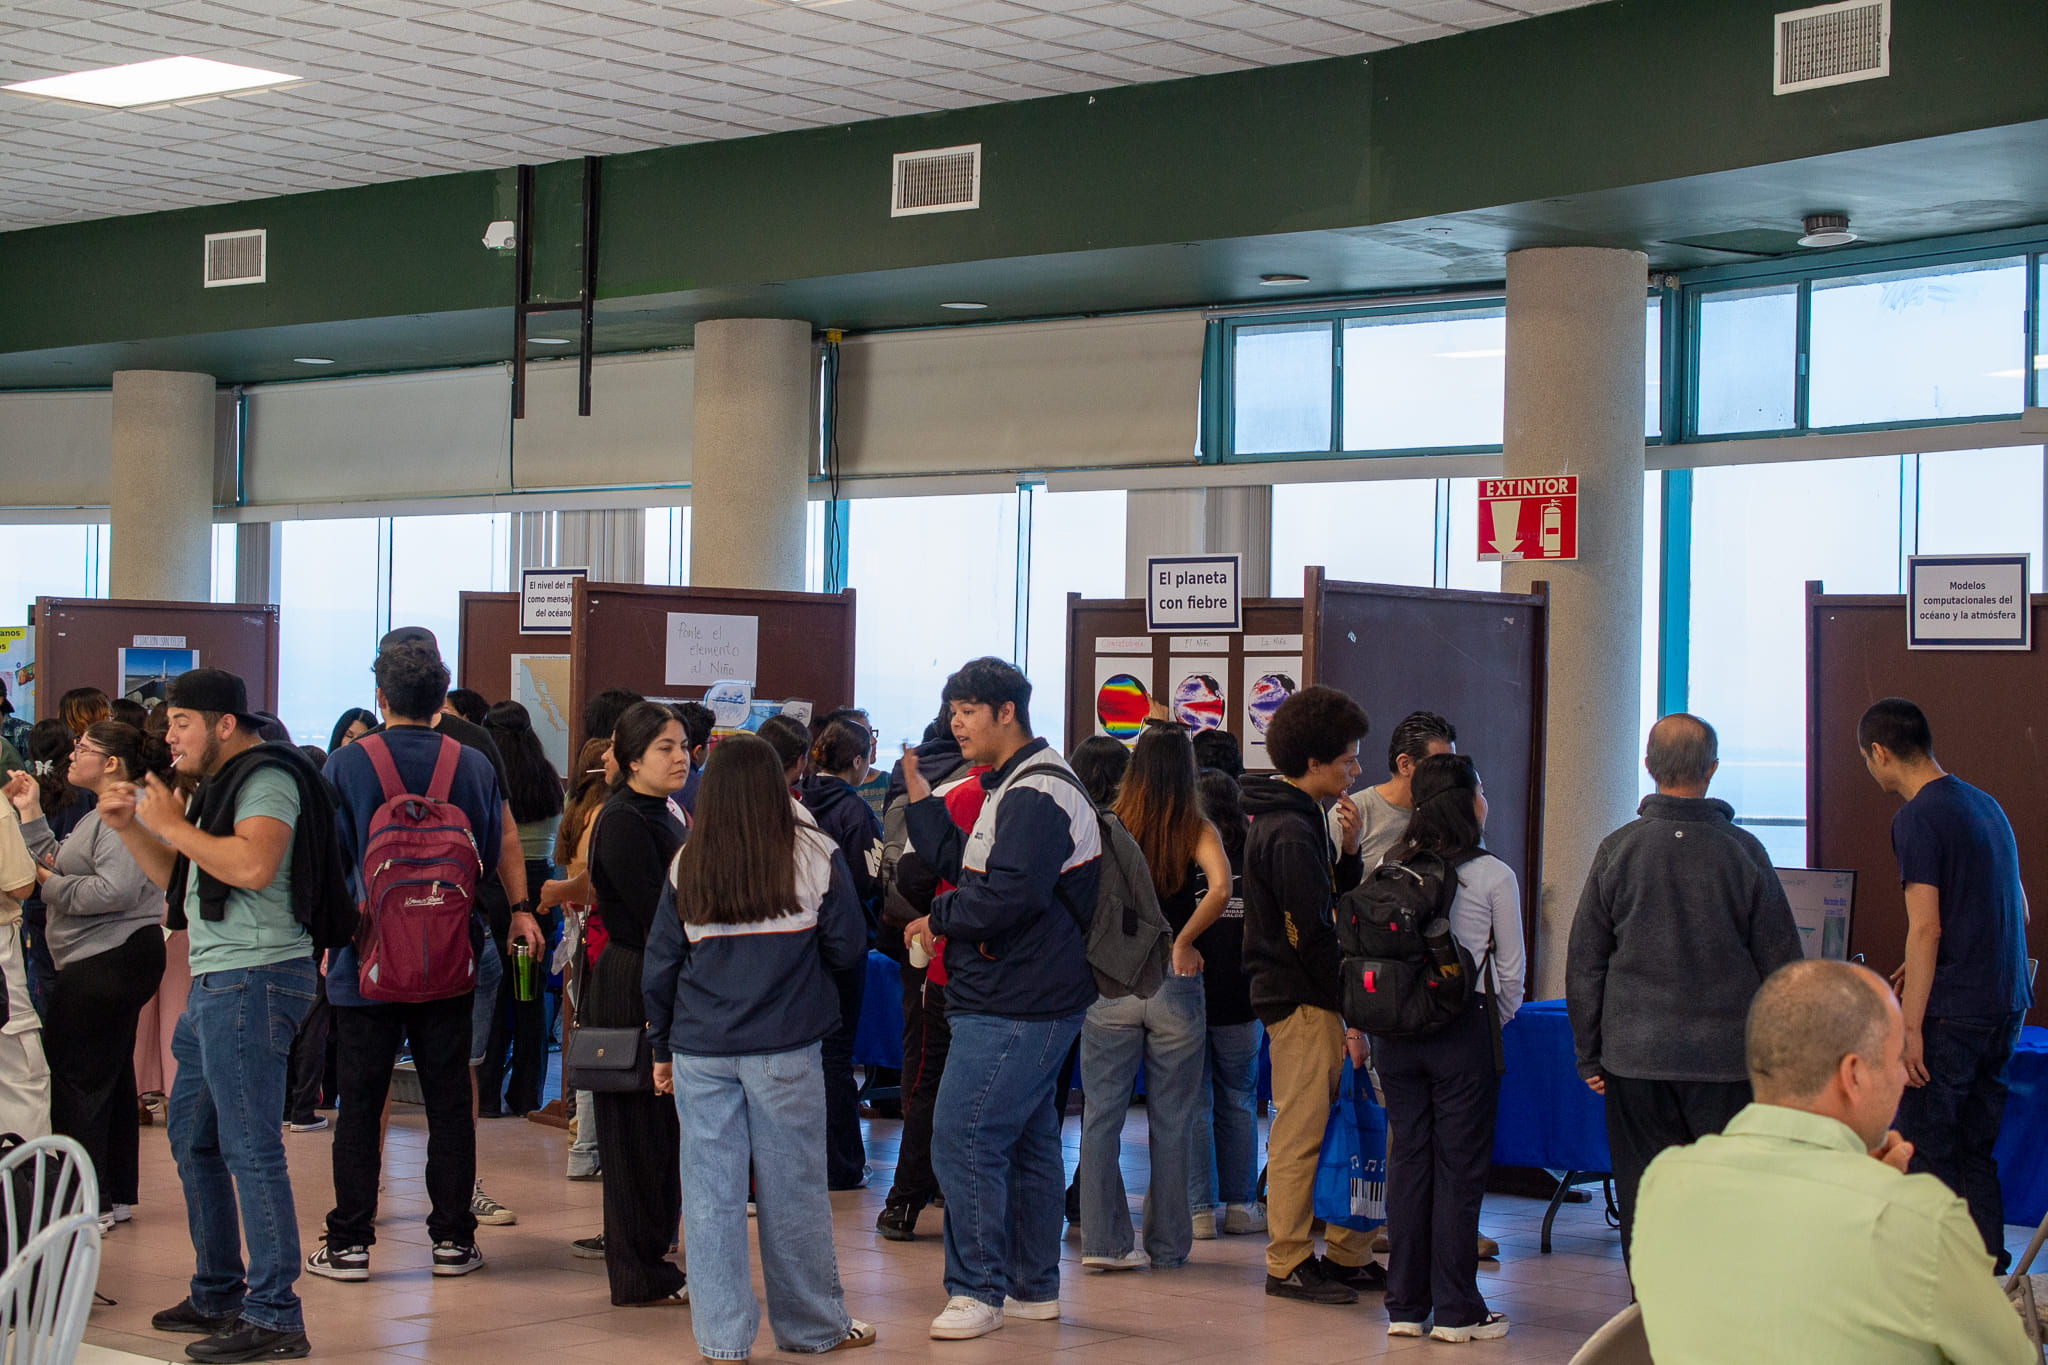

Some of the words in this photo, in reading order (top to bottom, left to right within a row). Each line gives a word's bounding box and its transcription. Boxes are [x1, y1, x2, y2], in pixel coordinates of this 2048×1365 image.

[1486, 478, 1569, 497] EXTINTOR
[529, 581, 536, 590] El
[537, 581, 553, 590] nivel
[554, 581, 566, 590] del
[1159, 571, 1171, 585] El
[1176, 571, 1227, 589] planeta
[1949, 581, 1986, 590] Modelos
[527, 595, 546, 604] como
[1159, 598, 1183, 610] con
[1187, 595, 1228, 609] fiebre
[1923, 596, 1997, 607] computacionales
[1998, 595, 2013, 604] del
[535, 609, 547, 617] del
[547, 608, 572, 618] océano
[1919, 610, 1951, 620] océano
[1952, 612, 1959, 621] y
[1960, 610, 1969, 619] la
[1970, 609, 2016, 620] atmósfera
[712, 626, 722, 640] el
[689, 642, 740, 657] elemento
[690, 660, 701, 674] al
[710, 662, 735, 676] Niño
